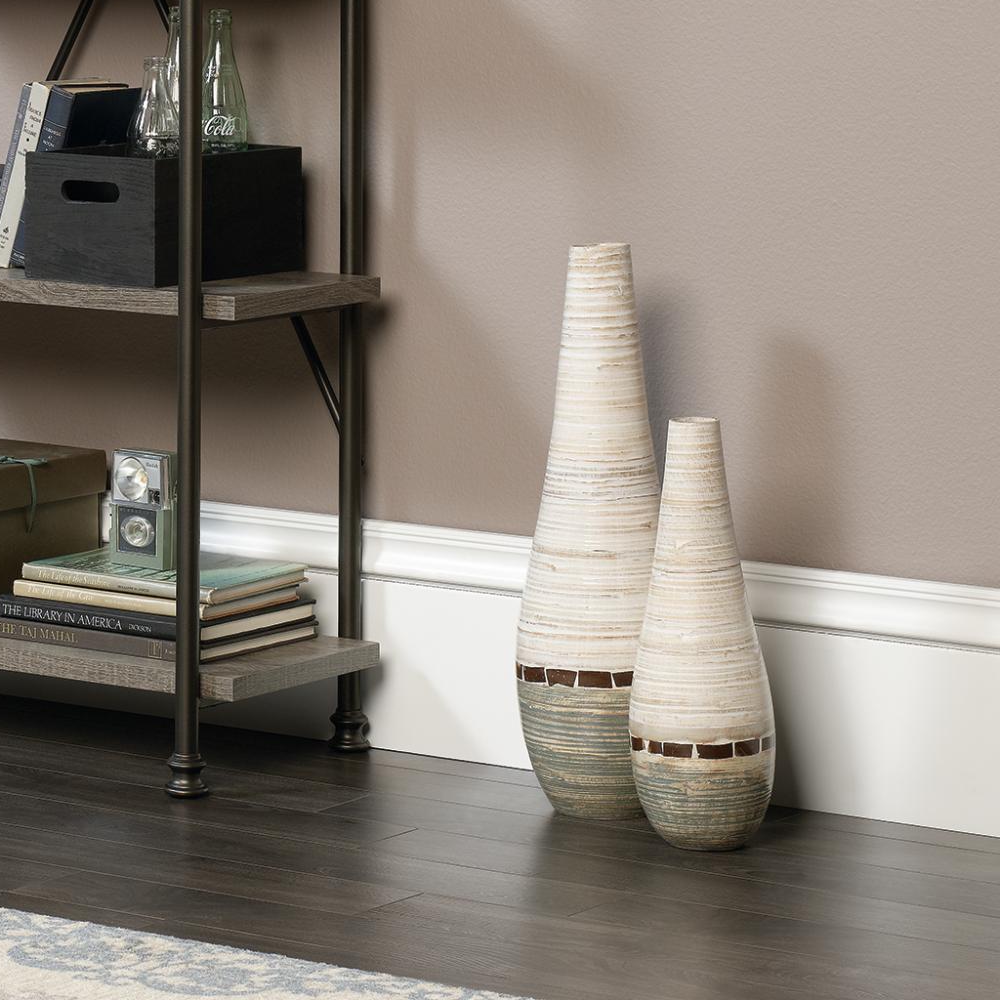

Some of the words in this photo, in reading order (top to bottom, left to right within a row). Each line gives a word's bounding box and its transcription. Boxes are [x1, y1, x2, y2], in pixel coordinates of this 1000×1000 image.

[204, 115, 237, 136] Cola
[38, 570, 50, 579] The
[3, 603, 22, 616] THE
[23, 606, 63, 621] LIBRARY
[64, 611, 76, 624] IN
[76, 614, 122, 630] AMERICA
[19, 625, 37, 639] TAJ
[40, 628, 79, 643] MAHAL
